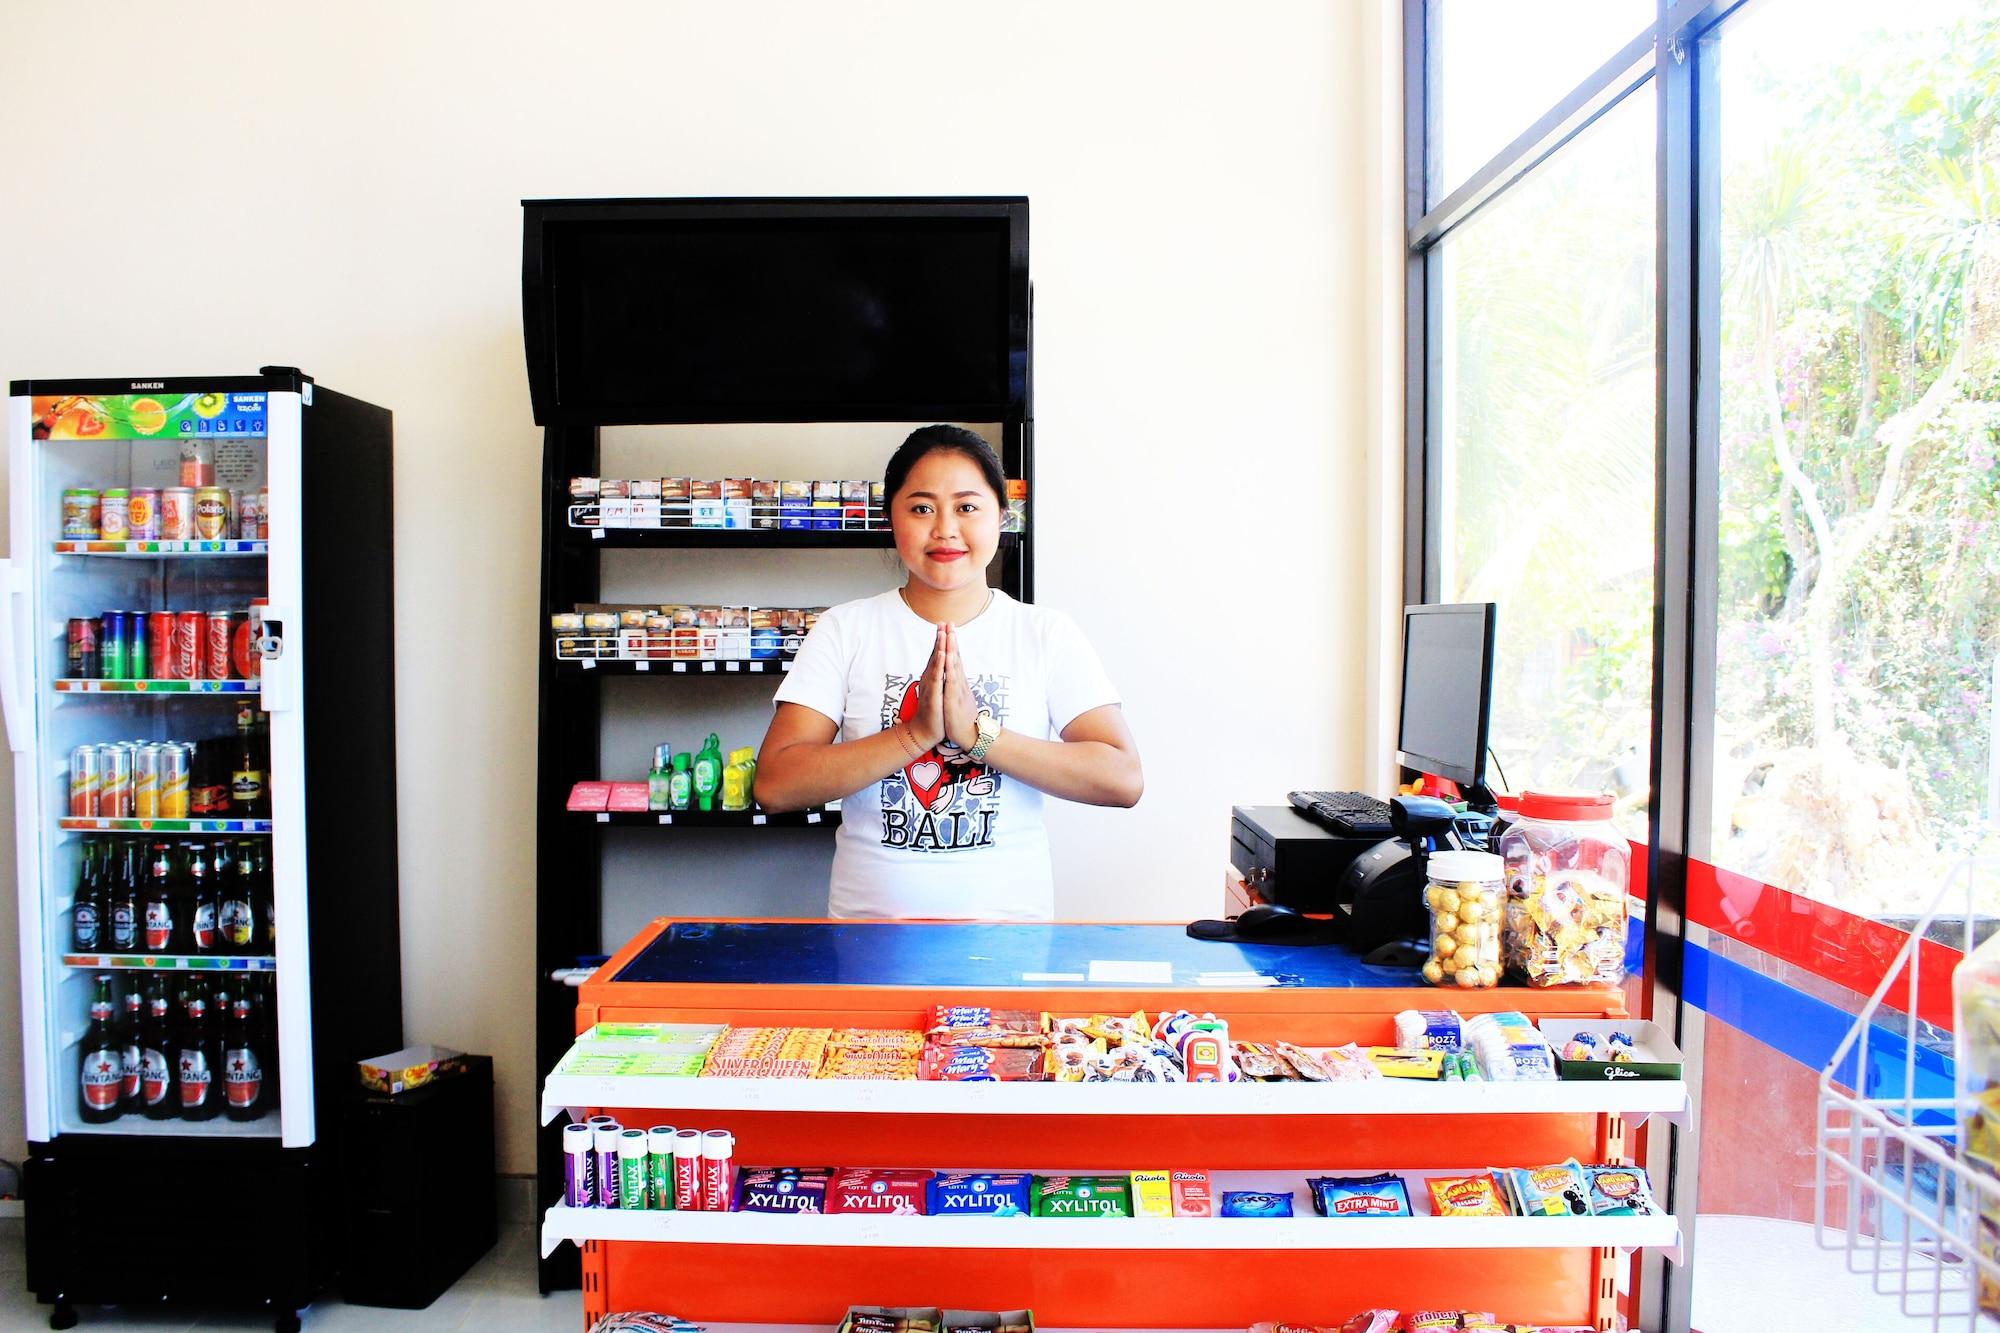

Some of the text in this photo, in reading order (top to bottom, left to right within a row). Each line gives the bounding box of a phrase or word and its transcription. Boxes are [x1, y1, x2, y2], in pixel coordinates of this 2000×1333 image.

[197, 504, 225, 514] Polaris
[881, 809, 995, 849] BALI
[944, 1063, 980, 1074] Mary
[1604, 1067, 1640, 1080] Glico
[1135, 1174, 1166, 1182] Ricola
[1174, 1173, 1205, 1181] Ricola
[628, 1165, 638, 1209] XYLITOL
[680, 1165, 690, 1208] XYLITOL
[708, 1166, 717, 1210] XYLITOL
[747, 1192, 818, 1211] XYLITOL
[843, 1194, 917, 1209] XYLITOL
[944, 1193, 1016, 1208] XYLITOL
[1050, 1200, 1122, 1213] XYLITOL
[1337, 1199, 1396, 1212] EXTRA MINT
[858, 1317, 895, 1327] TimTam
